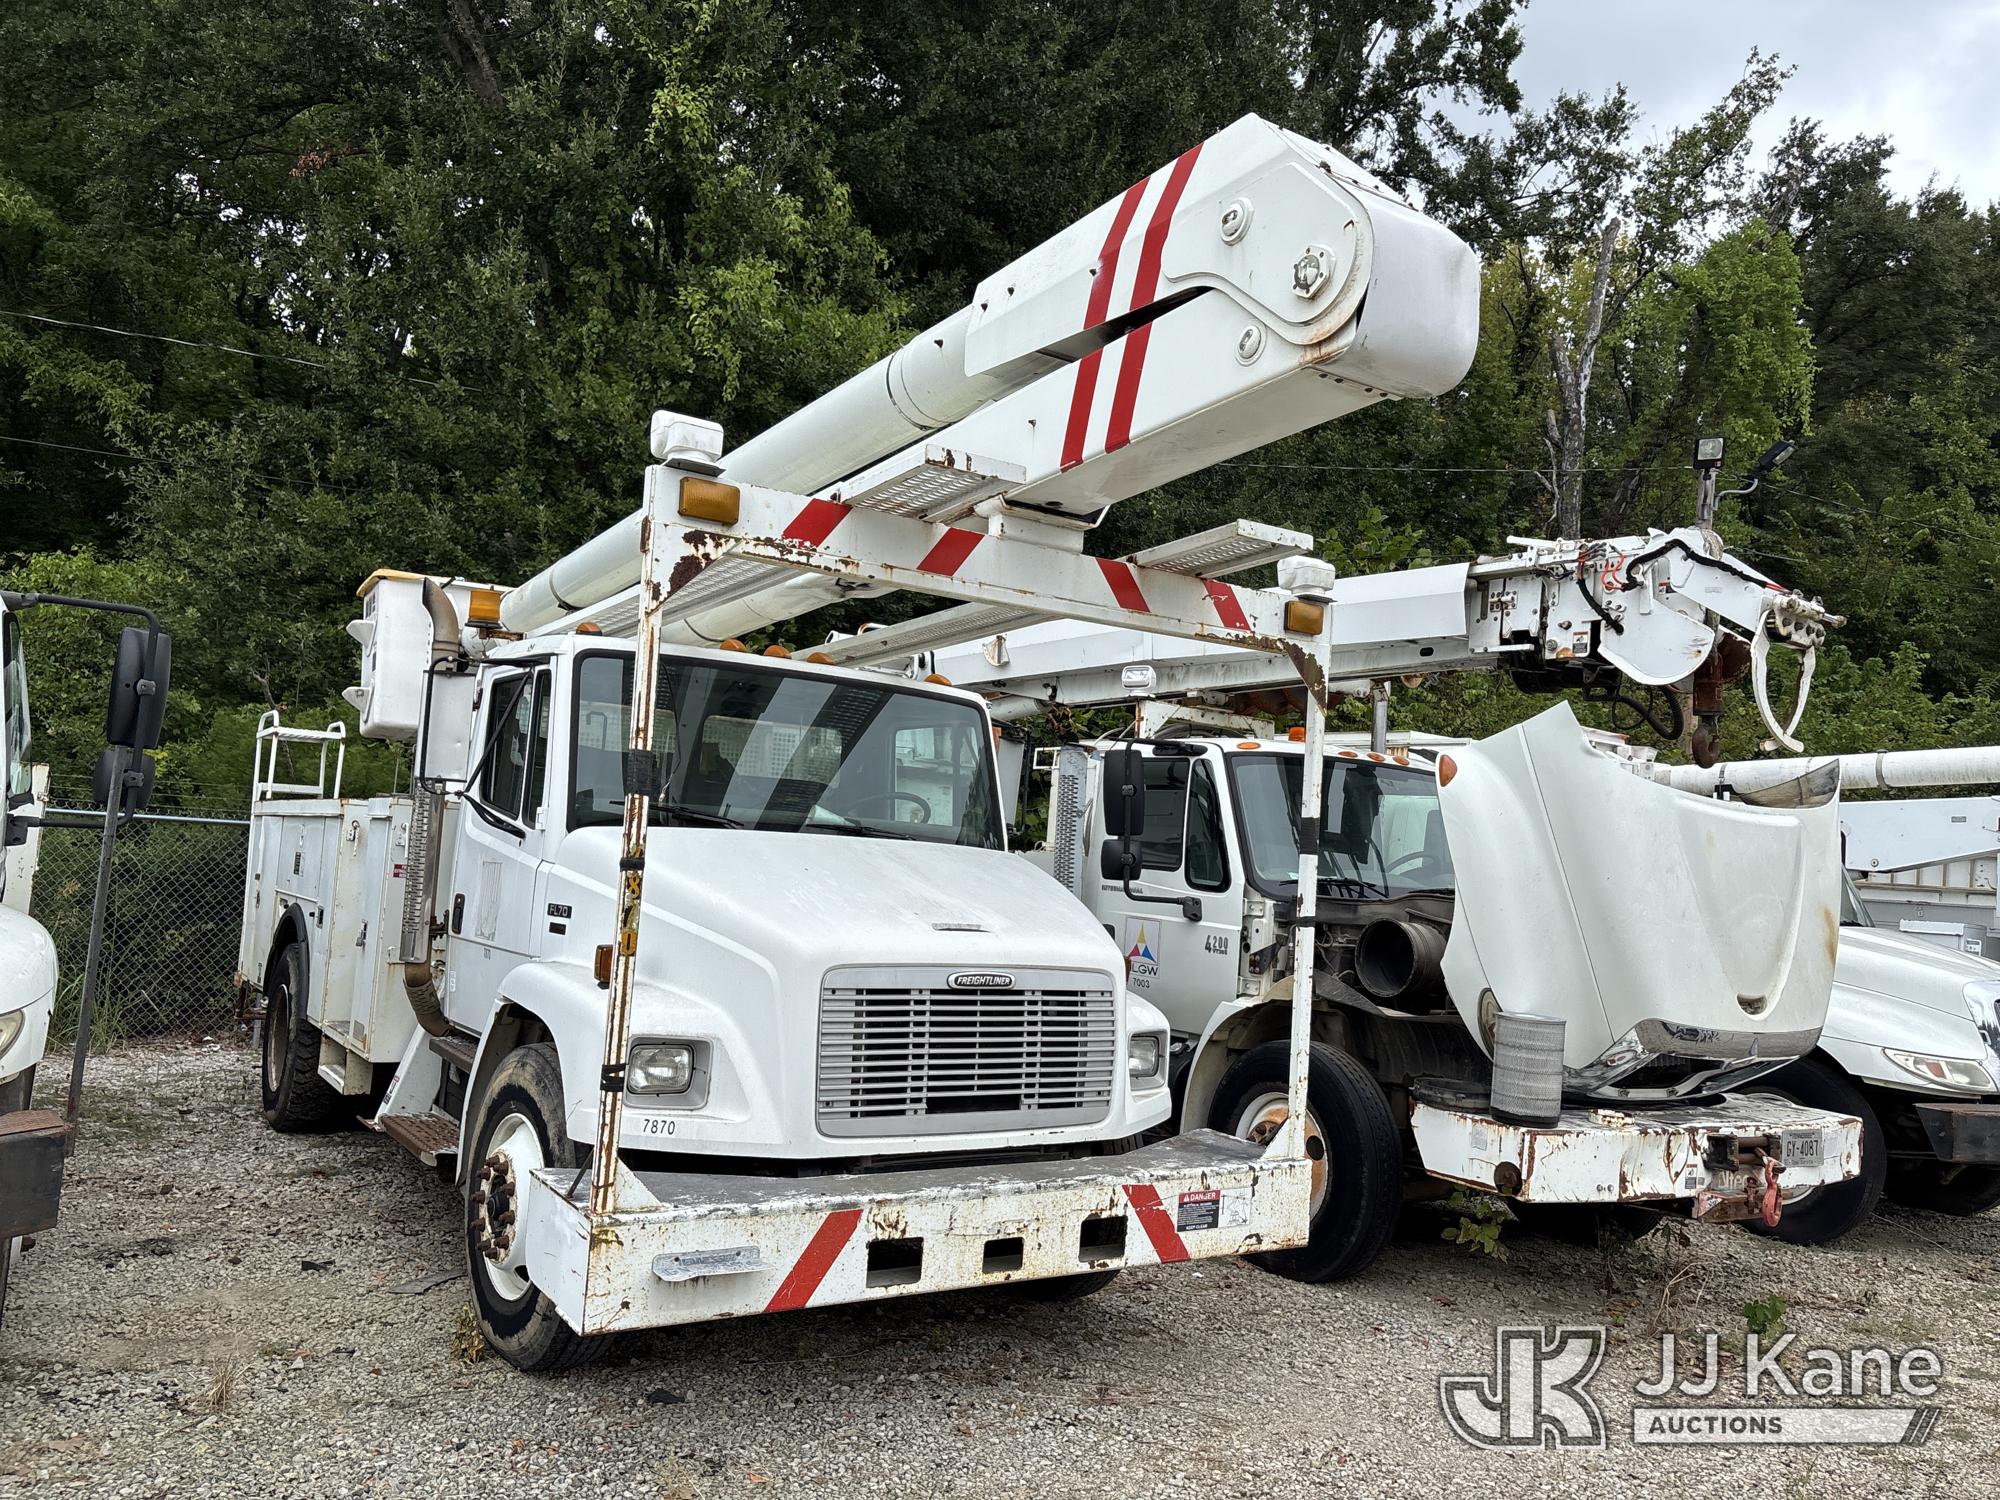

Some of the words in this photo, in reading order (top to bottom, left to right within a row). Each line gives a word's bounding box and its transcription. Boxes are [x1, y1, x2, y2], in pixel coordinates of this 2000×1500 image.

[549, 904, 568, 917] FL70
[1204, 934, 1229, 953] 4200
[1131, 963, 1159, 977] LGW
[956, 975, 1011, 985] FREIGHTLINER
[1132, 977, 1151, 989] 7003
[643, 1118, 676, 1136] 7870
[1786, 1139, 1819, 1157] GY-4087
[1190, 1192, 1216, 1201] DANGER
